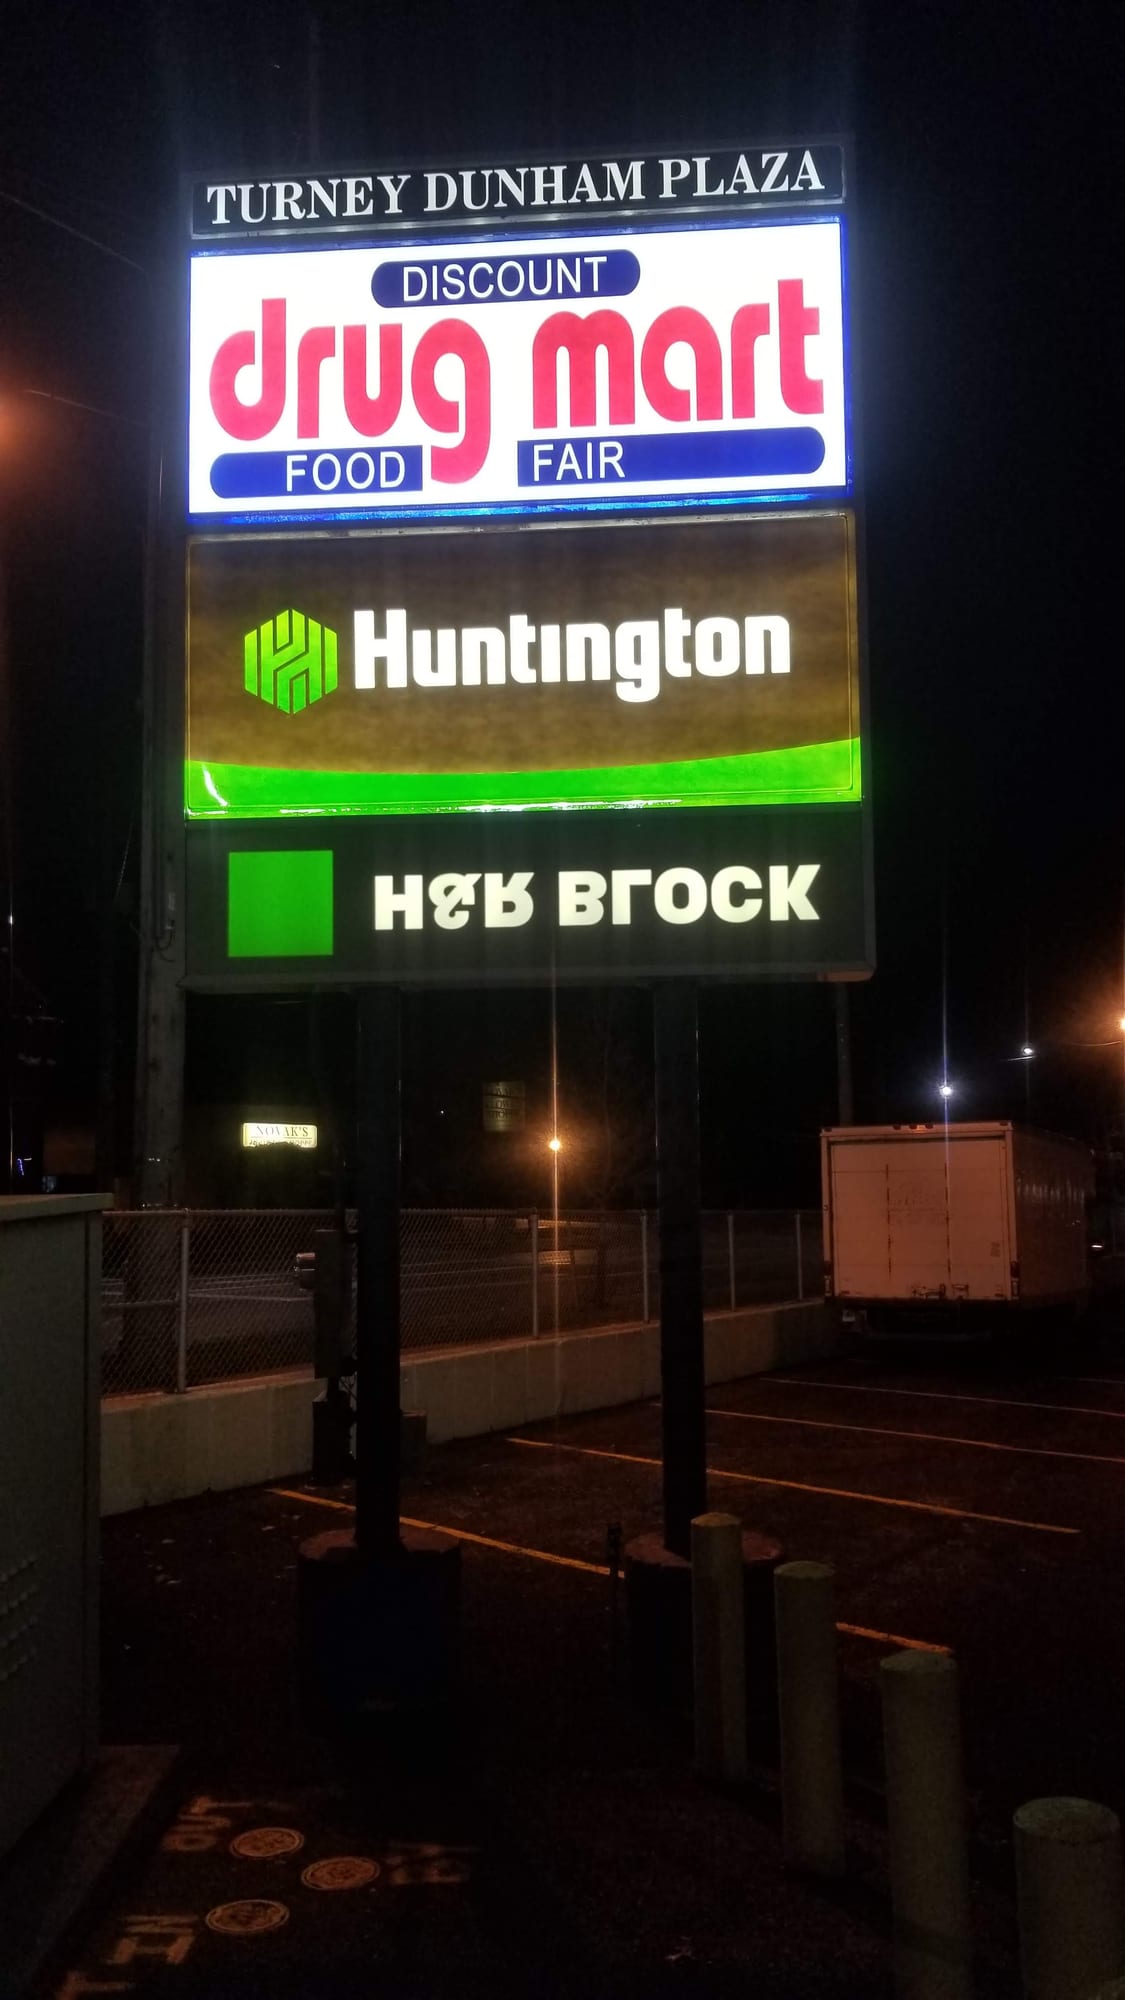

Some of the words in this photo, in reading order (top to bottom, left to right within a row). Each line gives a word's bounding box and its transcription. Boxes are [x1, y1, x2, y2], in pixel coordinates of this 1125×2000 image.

[206, 174, 411, 224] TURNEY
[423, 161, 645, 212] DUNHAM
[658, 150, 825, 196] PLAZA
[403, 256, 607, 302] DISCOUNT
[209, 298, 491, 485] drug
[533, 278, 824, 429] mart
[286, 450, 406, 492] FOOD
[534, 441, 626, 482] FAIR
[353, 608, 791, 703] Huntington
[256, 1125, 309, 1137] NOVAK'S
